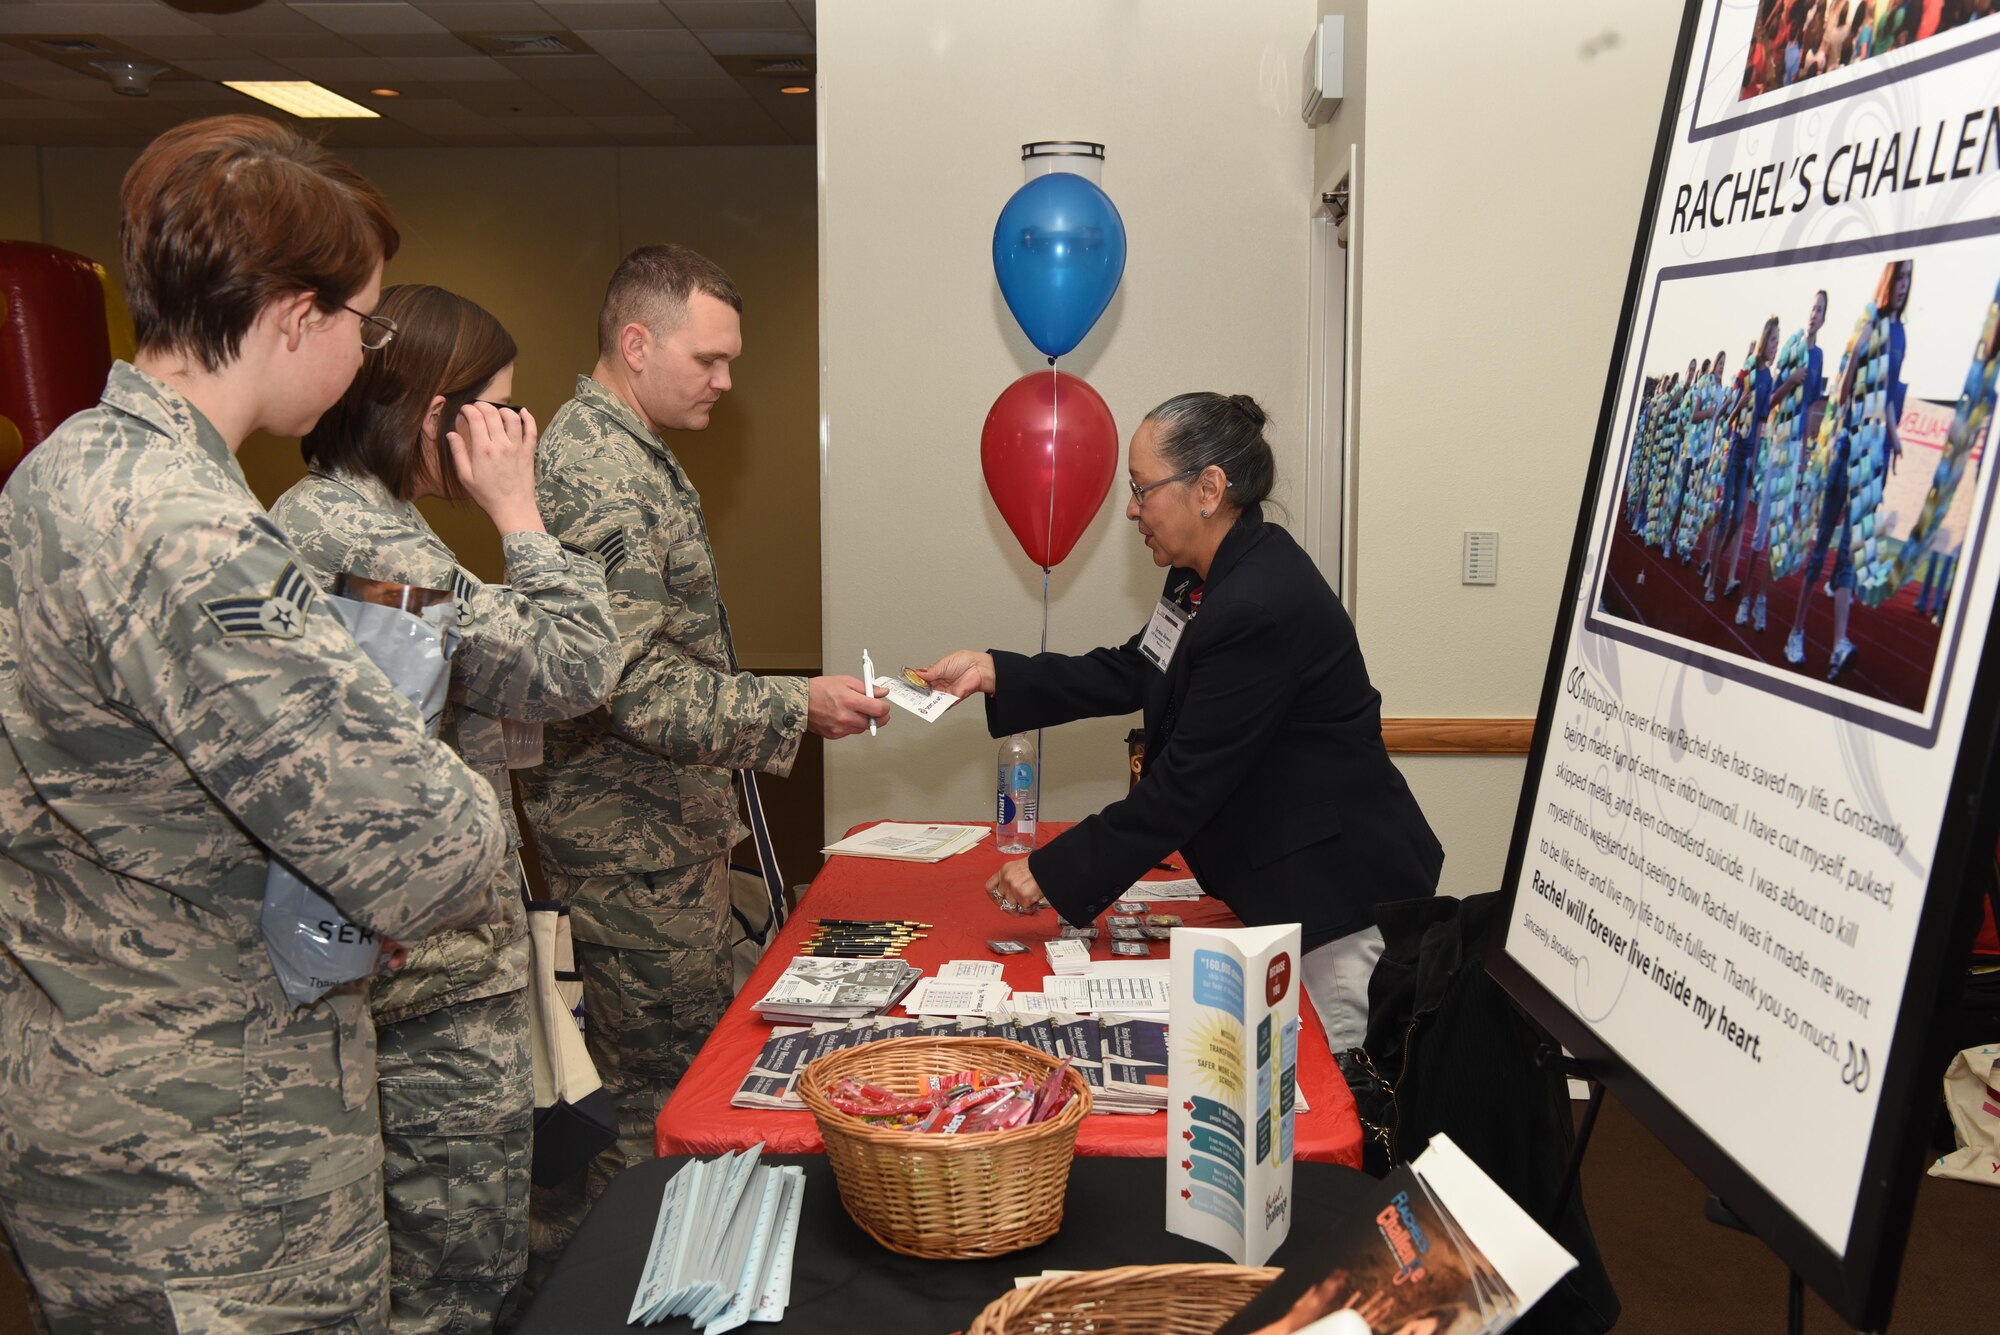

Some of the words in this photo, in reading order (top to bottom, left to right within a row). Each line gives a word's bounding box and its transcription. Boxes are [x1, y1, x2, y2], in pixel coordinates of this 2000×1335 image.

[1669, 152, 1819, 235] RACHEL'S
[1556, 763, 1589, 791] skipped
[1587, 782, 1613, 809] meals,
[1614, 797, 1633, 817] and
[1632, 806, 1656, 831] even
[1656, 819, 1706, 858] considerd
[1705, 847, 1745, 883] suicide.
[1749, 867, 1756, 888] I
[1756, 875, 1780, 902] was
[1780, 887, 1819, 926] about
[1819, 910, 1836, 935] to
[1835, 916, 1860, 948] kill
[1564, 722, 1587, 752] being
[1588, 741, 1611, 762] made
[1612, 745, 1628, 768] fun
[1628, 755, 1640, 774] of
[1639, 763, 1659, 786] sent
[1659, 773, 1676, 793] me
[1676, 777, 1697, 804] into
[1698, 790, 1739, 827] turmoil.
[1743, 810, 1750, 830] I
[1749, 812, 1777, 846] have
[1779, 833, 1800, 858] cut
[1800, 844, 1846, 885] myself,
[1845, 868, 1895, 911] puked,
[1622, 709, 1650, 732] never
[1650, 716, 1676, 744] knew
[1676, 728, 1711, 760] Rachel
[1710, 745, 1729, 769] she
[1730, 751, 1750, 779] has
[1751, 766, 1788, 794] saved
[1787, 782, 1807, 809] my
[1808, 785, 1830, 816] life.
[1833, 798, 1909, 856] Constantly
[1532, 869, 1567, 911] Rachel
[1566, 897, 1588, 926] will
[1586, 908, 1628, 957] forever
[1627, 938, 1651, 975] live
[1651, 956, 1692, 1007] inside
[1692, 994, 1717, 1030] my
[1716, 1005, 1762, 1064] heart.
[1539, 837, 1550, 855] to
[1549, 841, 1560, 863] be
[1559, 848, 1575, 873] like
[1574, 857, 1590, 882] her
[1589, 873, 1608, 894] and
[1606, 879, 1622, 906] live
[1622, 895, 1638, 919] my
[1637, 900, 1653, 928] life
[1653, 915, 1665, 935] to
[1666, 922, 1684, 949] the
[1683, 931, 1718, 974] fullest.
[1722, 958, 1757, 1002] Thank
[1755, 988, 1783, 1019] you
[1782, 1006, 1799, 1030] so
[1799, 1019, 1841, 1062] much.
[1548, 802, 1575, 828] myself
[1573, 815, 1589, 837] this
[1590, 827, 1630, 861] weekend
[1628, 843, 1646, 873] but
[1645, 861, 1677, 897] seeing
[1677, 876, 1701, 907] how
[1701, 892, 1740, 933] Rachel
[1738, 919, 1762, 948] was
[1762, 930, 1774, 955] it
[1772, 943, 1810, 979] made
[1810, 967, 1833, 995] me
[1834, 982, 1872, 1020] want
